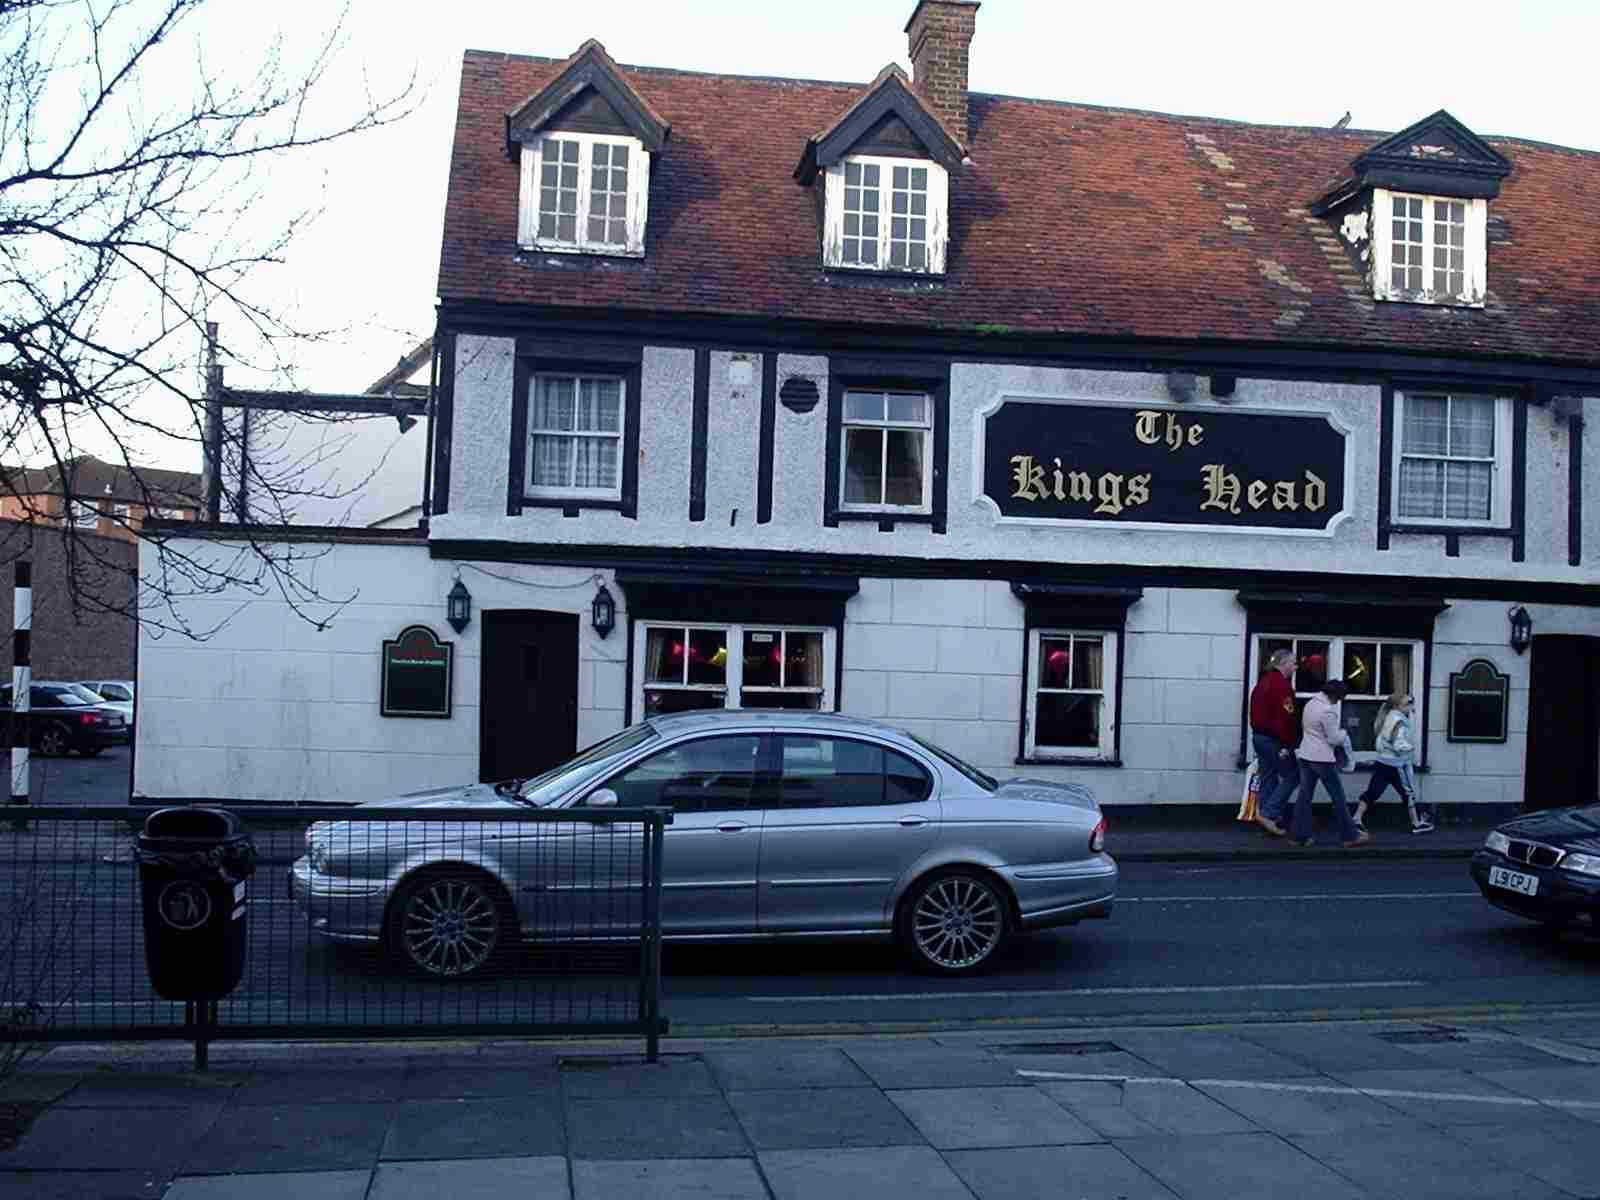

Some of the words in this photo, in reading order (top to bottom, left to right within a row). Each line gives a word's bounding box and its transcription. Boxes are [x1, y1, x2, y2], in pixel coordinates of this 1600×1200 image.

[1135, 410, 1204, 451] The
[1010, 455, 1151, 514] Kings
[1200, 464, 1326, 514] Head
